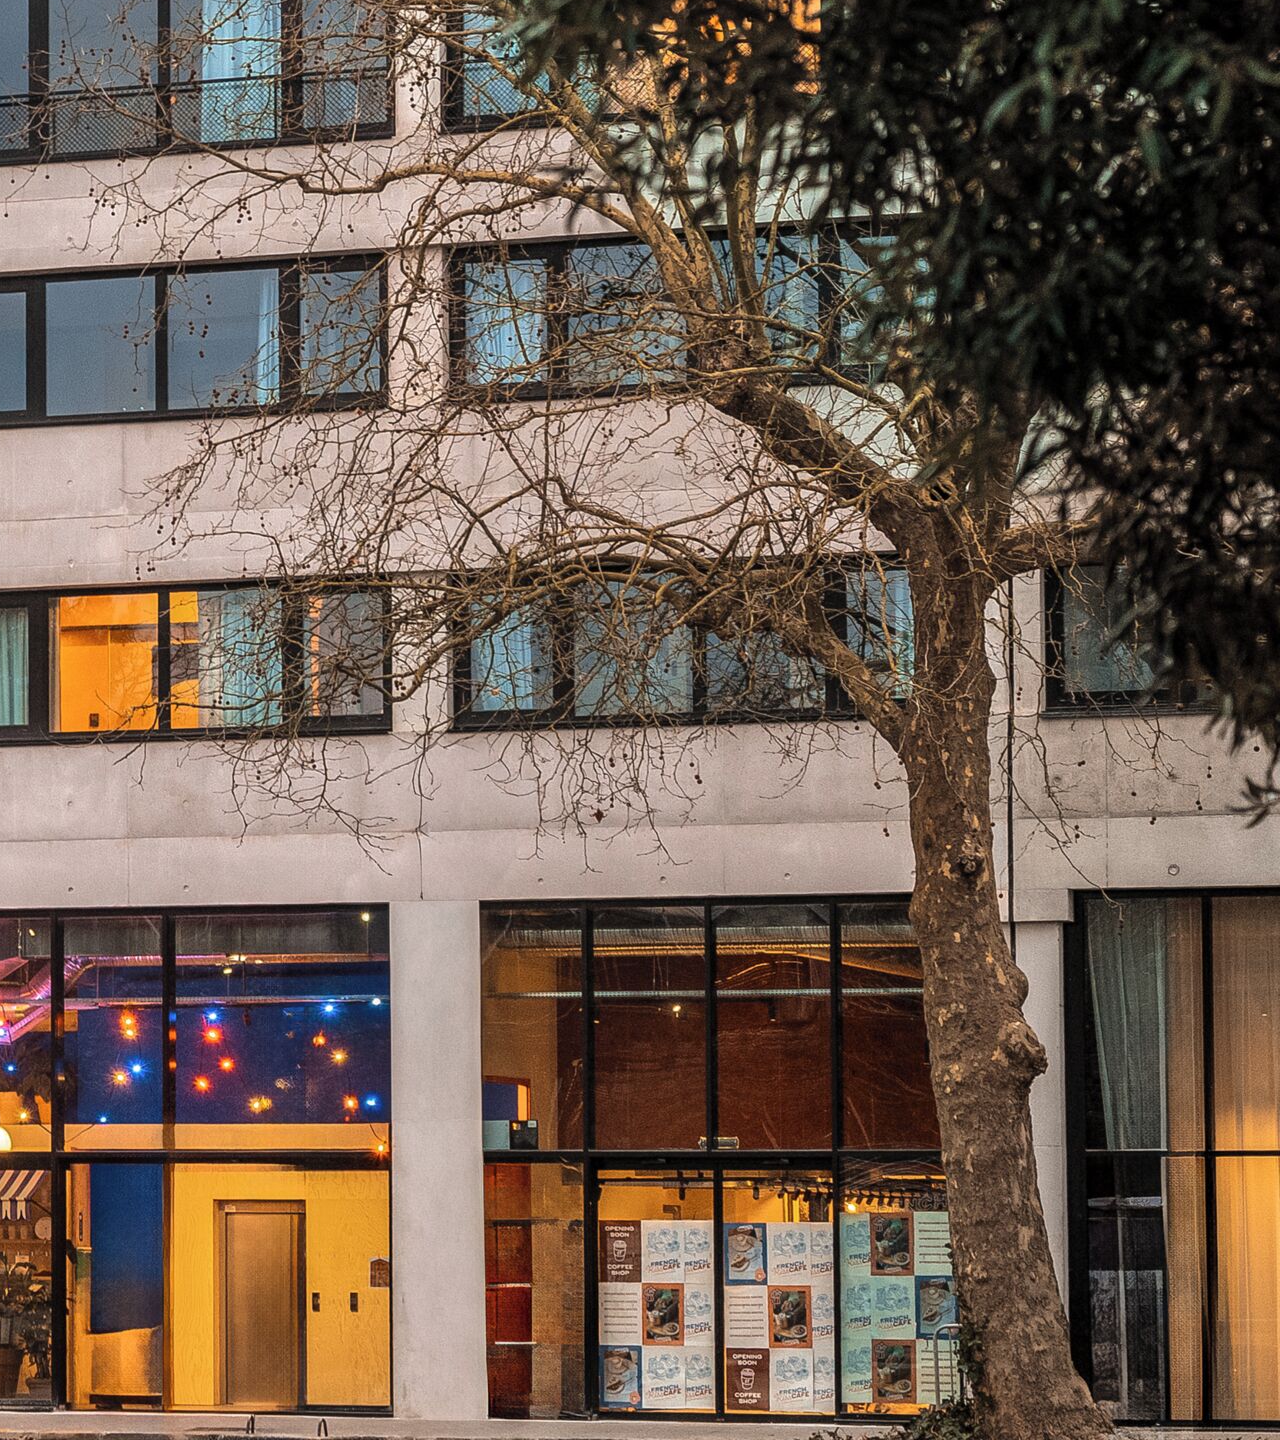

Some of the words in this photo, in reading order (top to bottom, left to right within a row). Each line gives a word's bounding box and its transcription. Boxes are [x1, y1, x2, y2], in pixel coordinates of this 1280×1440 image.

[650, 1259, 678, 1267] FRENCH
[684, 1259, 708, 1267] RENCH
[776, 1260, 804, 1268] FRENCH
[880, 1315, 909, 1323] FRENCH
[686, 1321, 709, 1329] RENCH
[651, 1384, 679, 1392] FRENCH
[686, 1384, 710, 1392] RENCH
[779, 1386, 807, 1395] FRENCH
